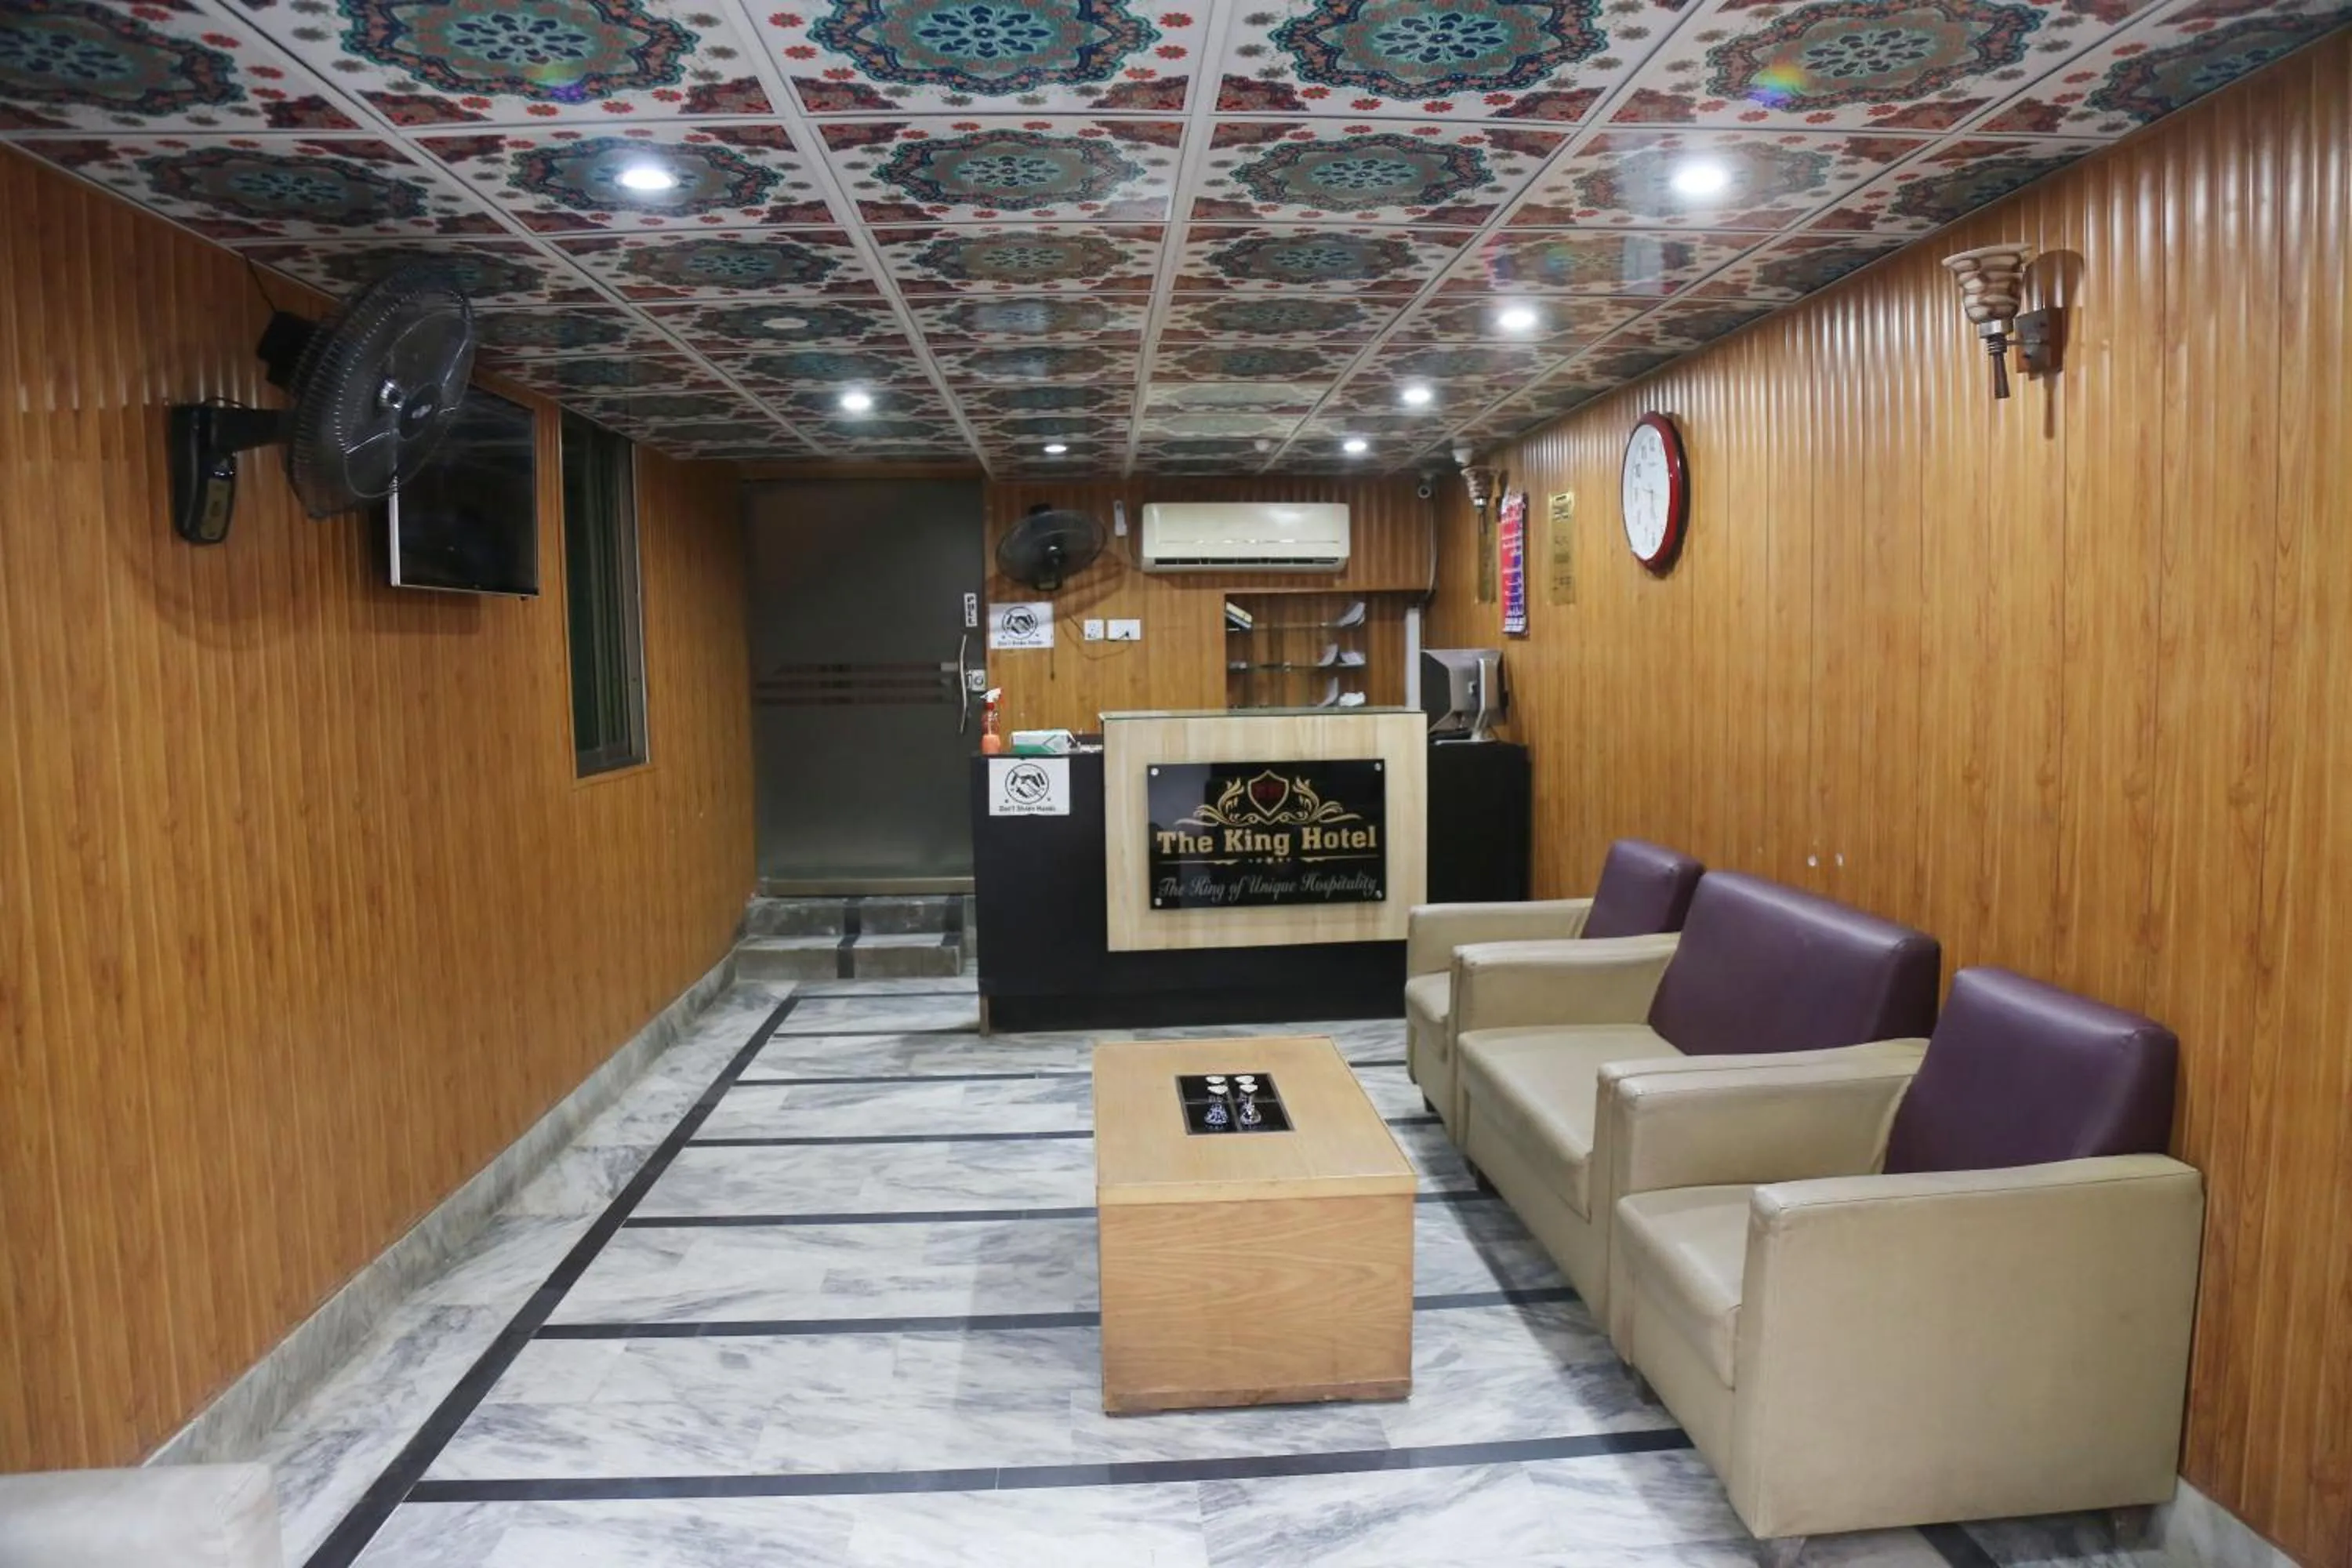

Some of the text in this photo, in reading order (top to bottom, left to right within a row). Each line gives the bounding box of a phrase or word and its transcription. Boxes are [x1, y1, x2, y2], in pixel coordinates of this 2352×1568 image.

[1156, 825, 1377, 856] The King Hotel
[1158, 869, 1377, 904] The King of Unique Hospitality
